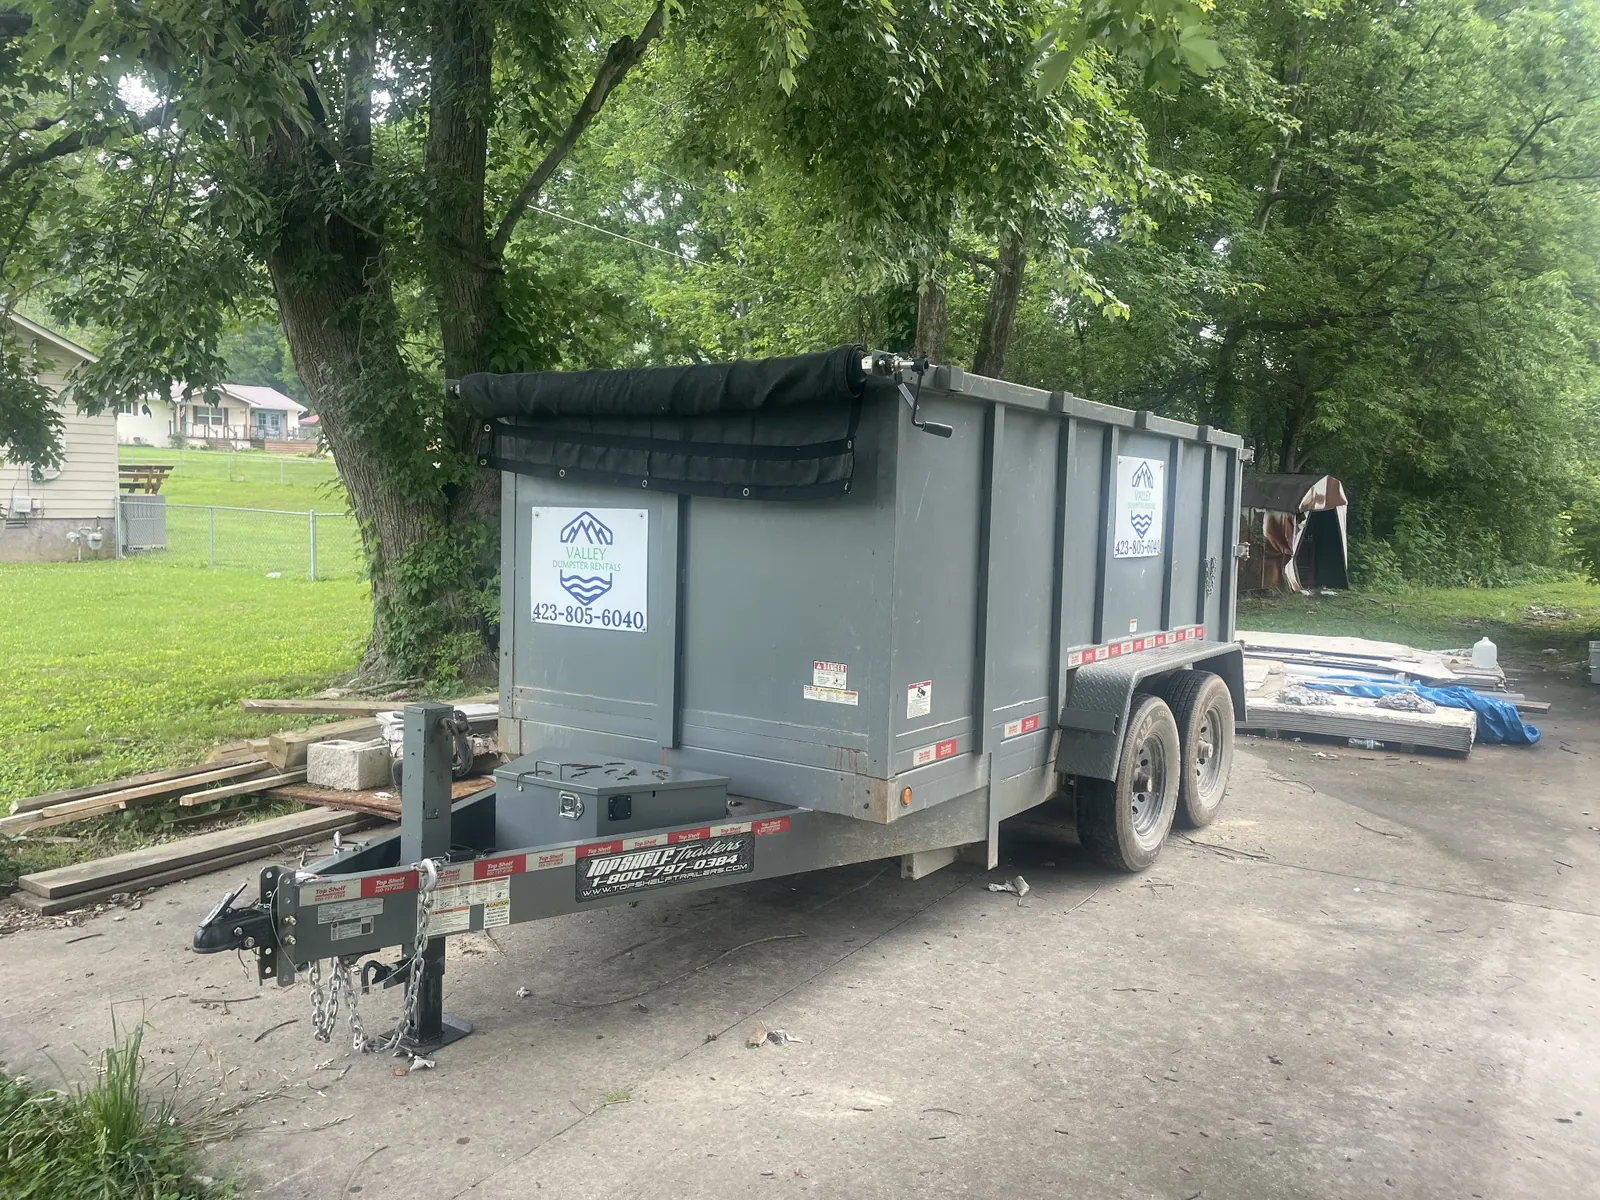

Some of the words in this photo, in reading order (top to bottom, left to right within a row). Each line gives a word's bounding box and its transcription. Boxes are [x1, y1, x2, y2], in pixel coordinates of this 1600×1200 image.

[1134, 490, 1151, 501] VALLEY
[566, 546, 606, 560] VALLEY
[553, 560, 588, 570] DUMPSTER
[590, 562, 621, 571] RENTALS
[533, 603, 644, 629] 423-805-6040
[586, 847, 678, 878] TOPSHELF
[673, 839, 742, 864] Trailers
[591, 854, 738, 887] 1-800-797-0384
